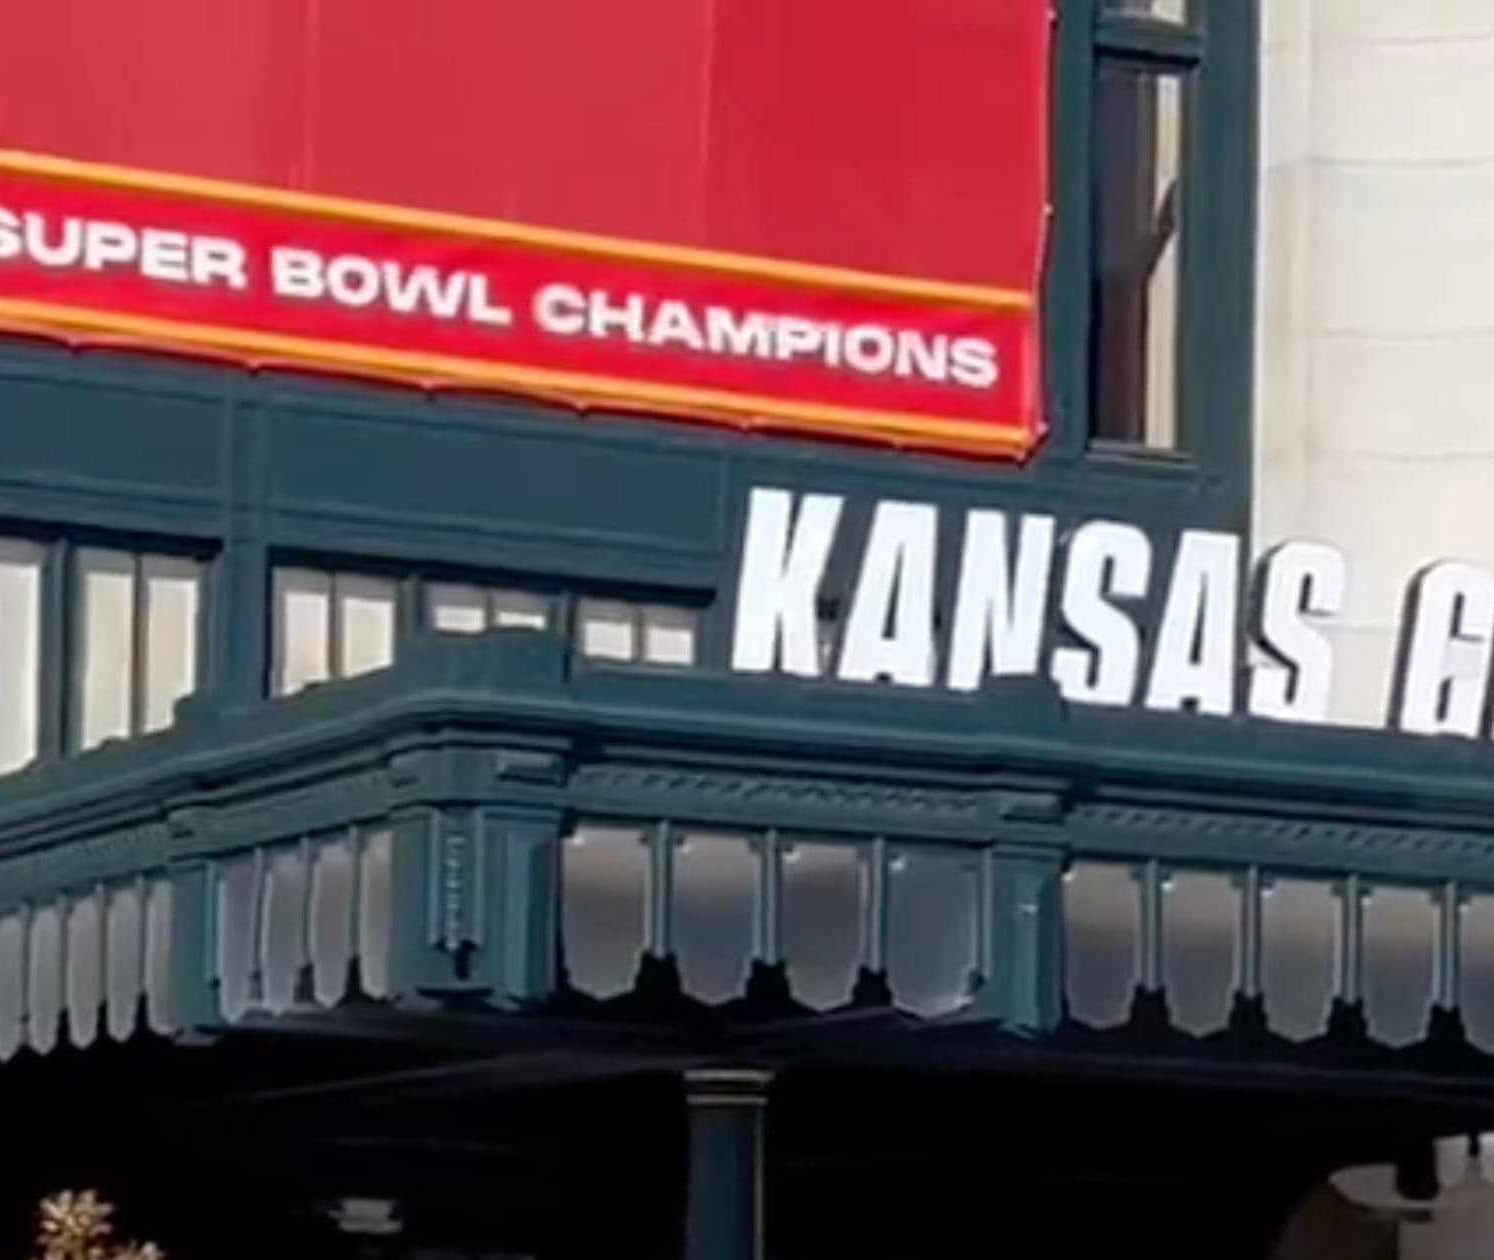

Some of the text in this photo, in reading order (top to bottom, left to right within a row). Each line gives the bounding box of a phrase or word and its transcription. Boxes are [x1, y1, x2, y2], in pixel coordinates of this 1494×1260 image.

[272, 247, 512, 324] BOWL
[533, 285, 999, 388] CHAMPIONS
[731, 486, 1350, 724] KANSAS
